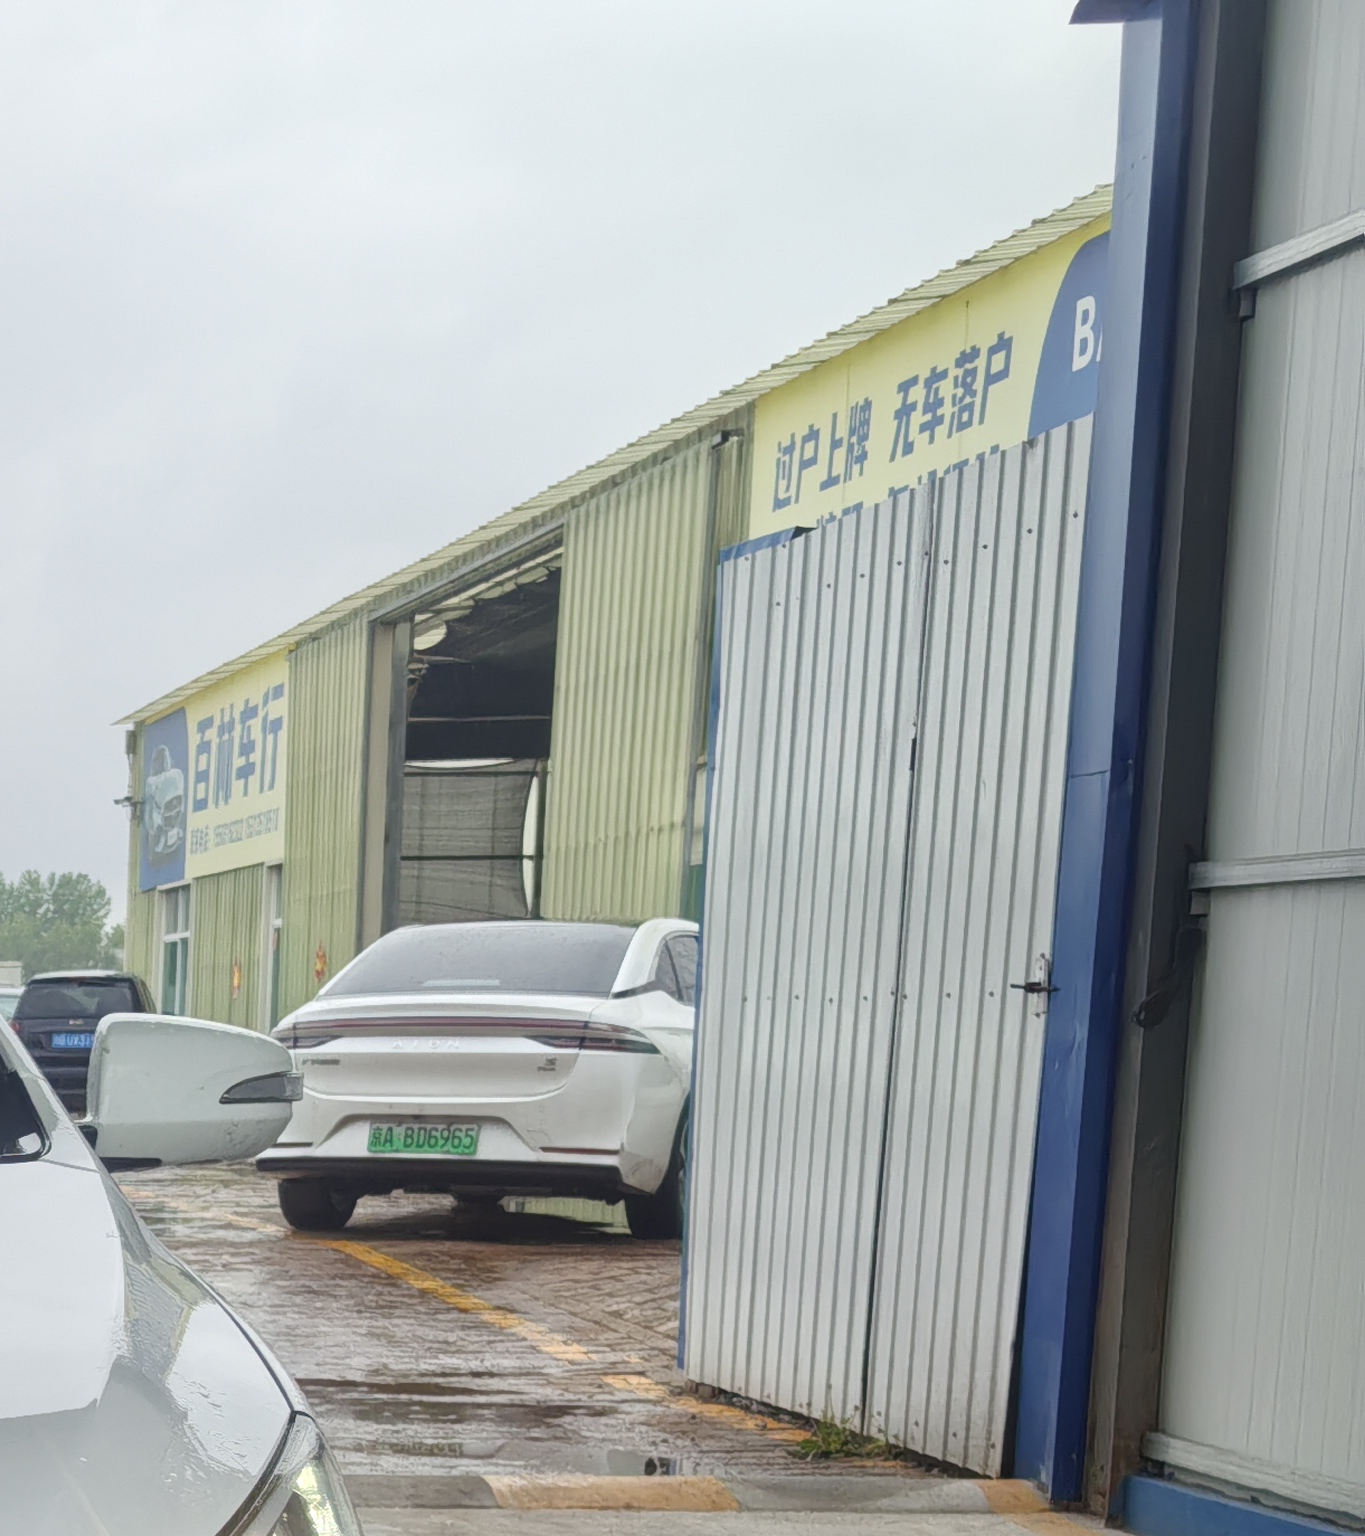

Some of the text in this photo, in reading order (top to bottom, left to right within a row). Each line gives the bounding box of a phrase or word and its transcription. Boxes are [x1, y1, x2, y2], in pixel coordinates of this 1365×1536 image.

[1072, 296, 1102, 372] B
[773, 397, 872, 512] 过户上牌
[889, 330, 1013, 463] 无车落户
